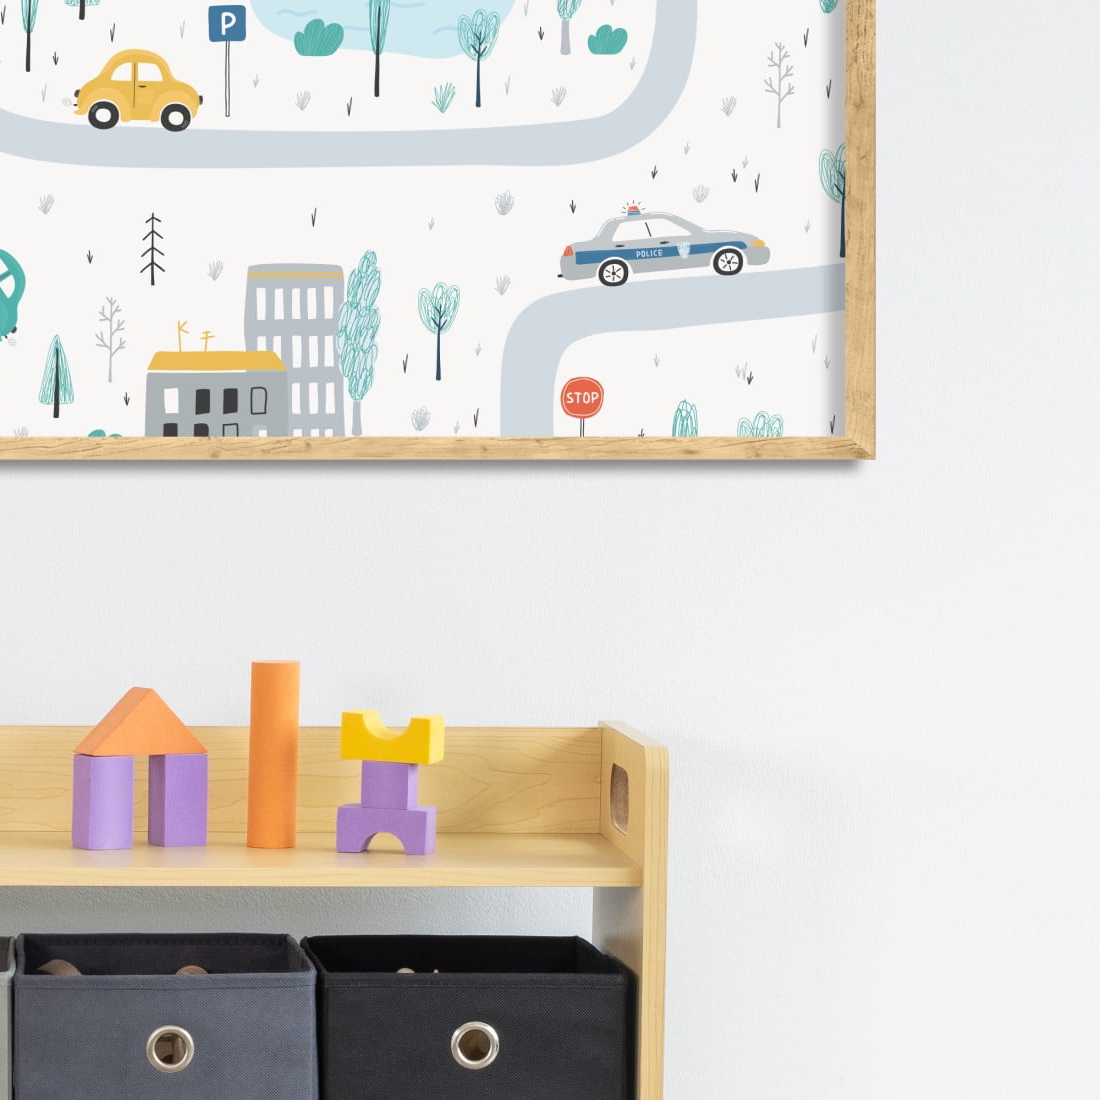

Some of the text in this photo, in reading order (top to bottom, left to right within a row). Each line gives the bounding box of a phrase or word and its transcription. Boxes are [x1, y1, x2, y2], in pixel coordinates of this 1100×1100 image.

[221, 11, 237, 36] P
[635, 249, 664, 259] POLICE
[566, 391, 599, 404] STOP
